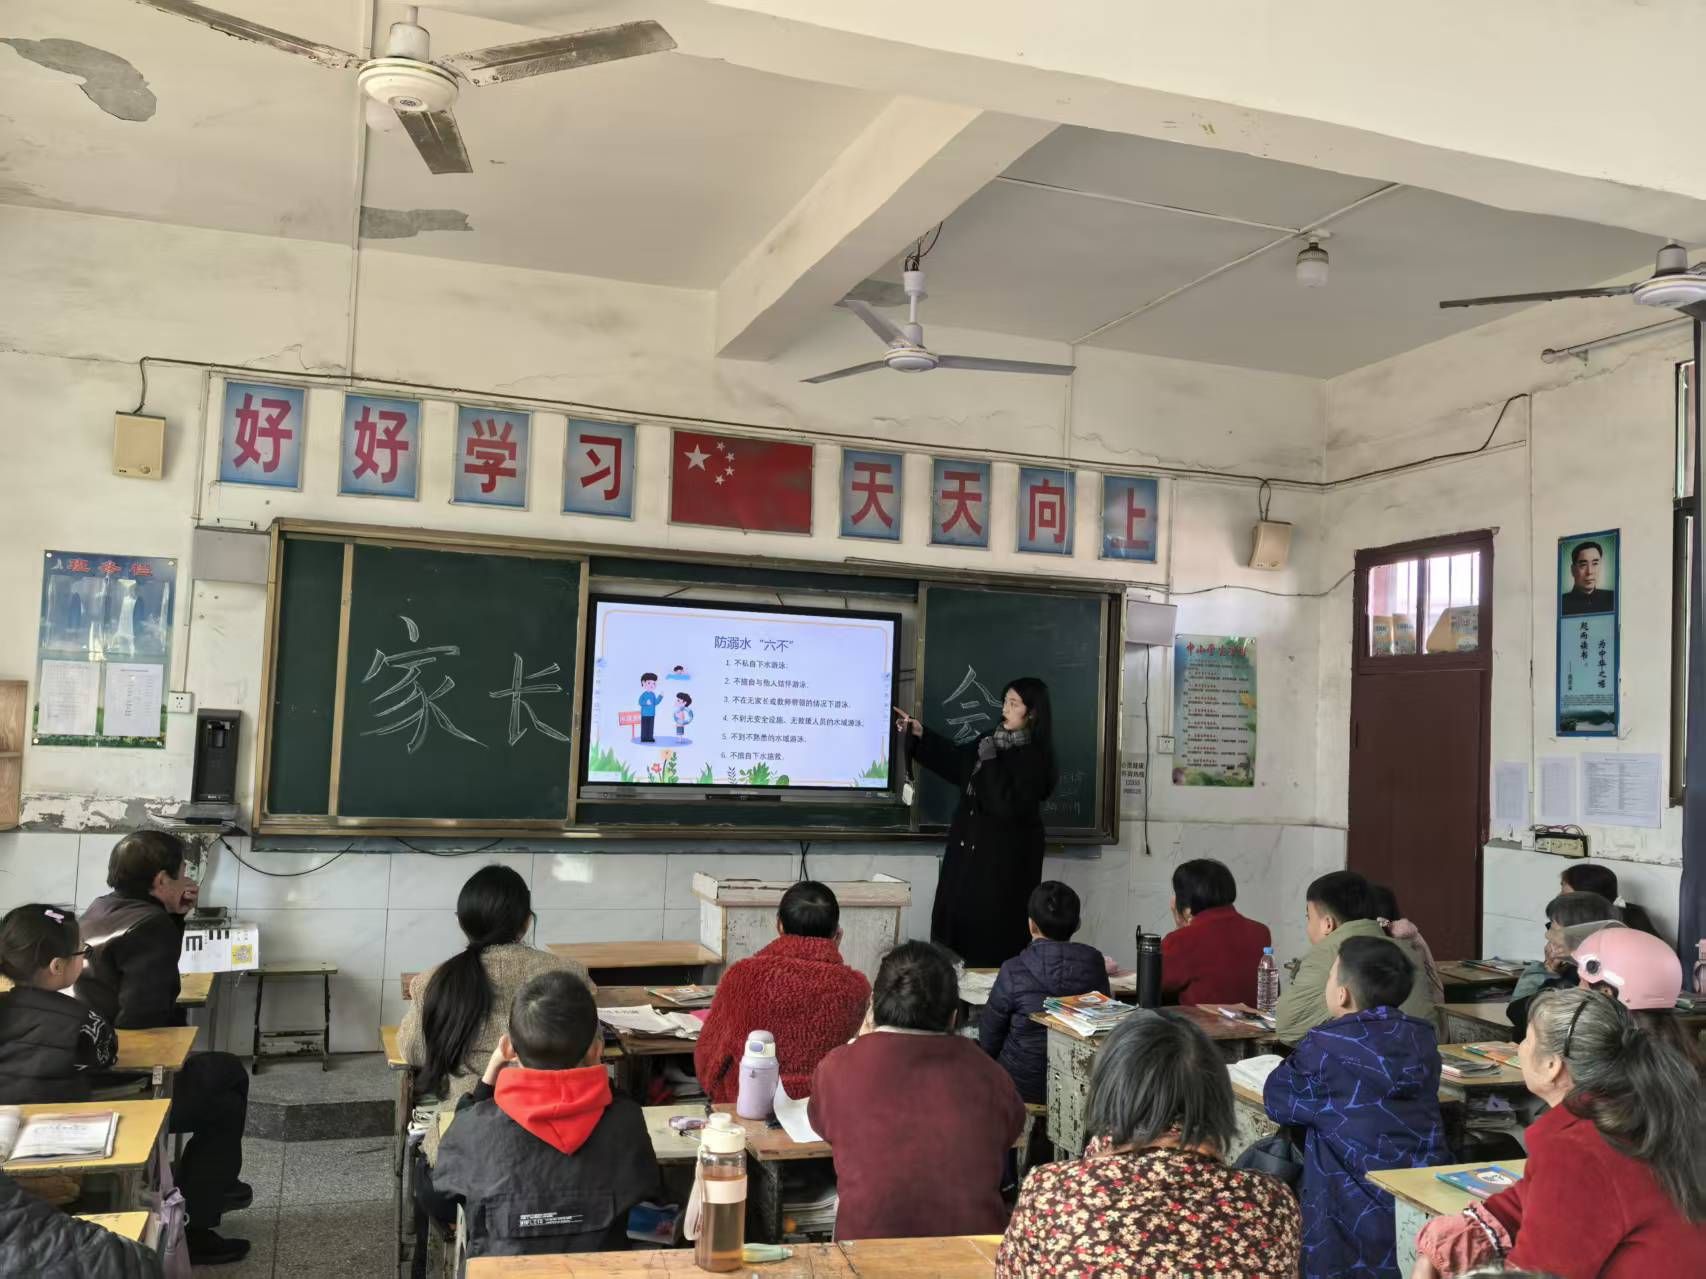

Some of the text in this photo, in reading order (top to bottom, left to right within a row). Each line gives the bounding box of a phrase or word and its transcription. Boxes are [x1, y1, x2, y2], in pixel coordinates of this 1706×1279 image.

[231, 392, 1149, 549] 好好学习 天天向上
[359, 615, 571, 754] 家长
